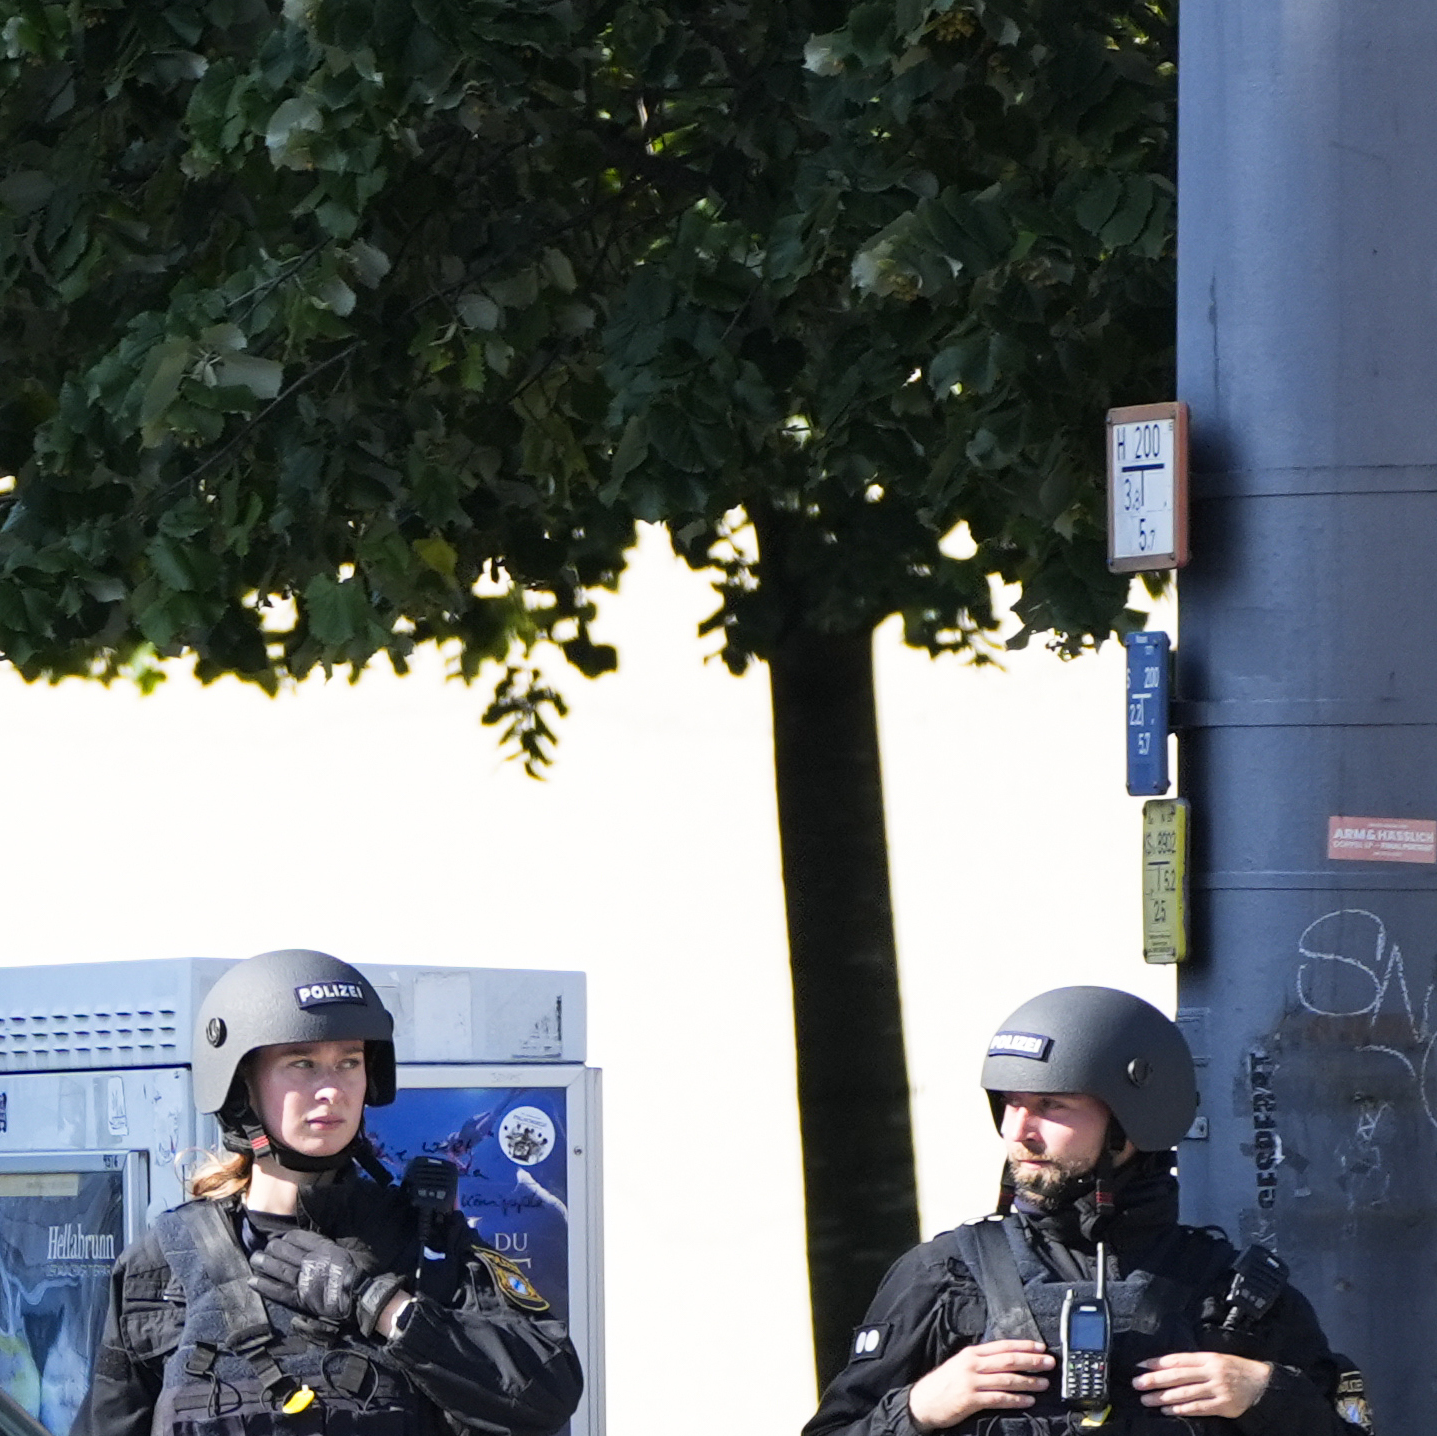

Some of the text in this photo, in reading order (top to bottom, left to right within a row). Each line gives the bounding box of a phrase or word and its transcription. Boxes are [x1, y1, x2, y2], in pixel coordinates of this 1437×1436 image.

[1117, 423, 1161, 461] H 200
[298, 984, 364, 1003] POLIZEI
[47, 1223, 115, 1260] Hellabrunn
[495, 1232, 527, 1251] DU
